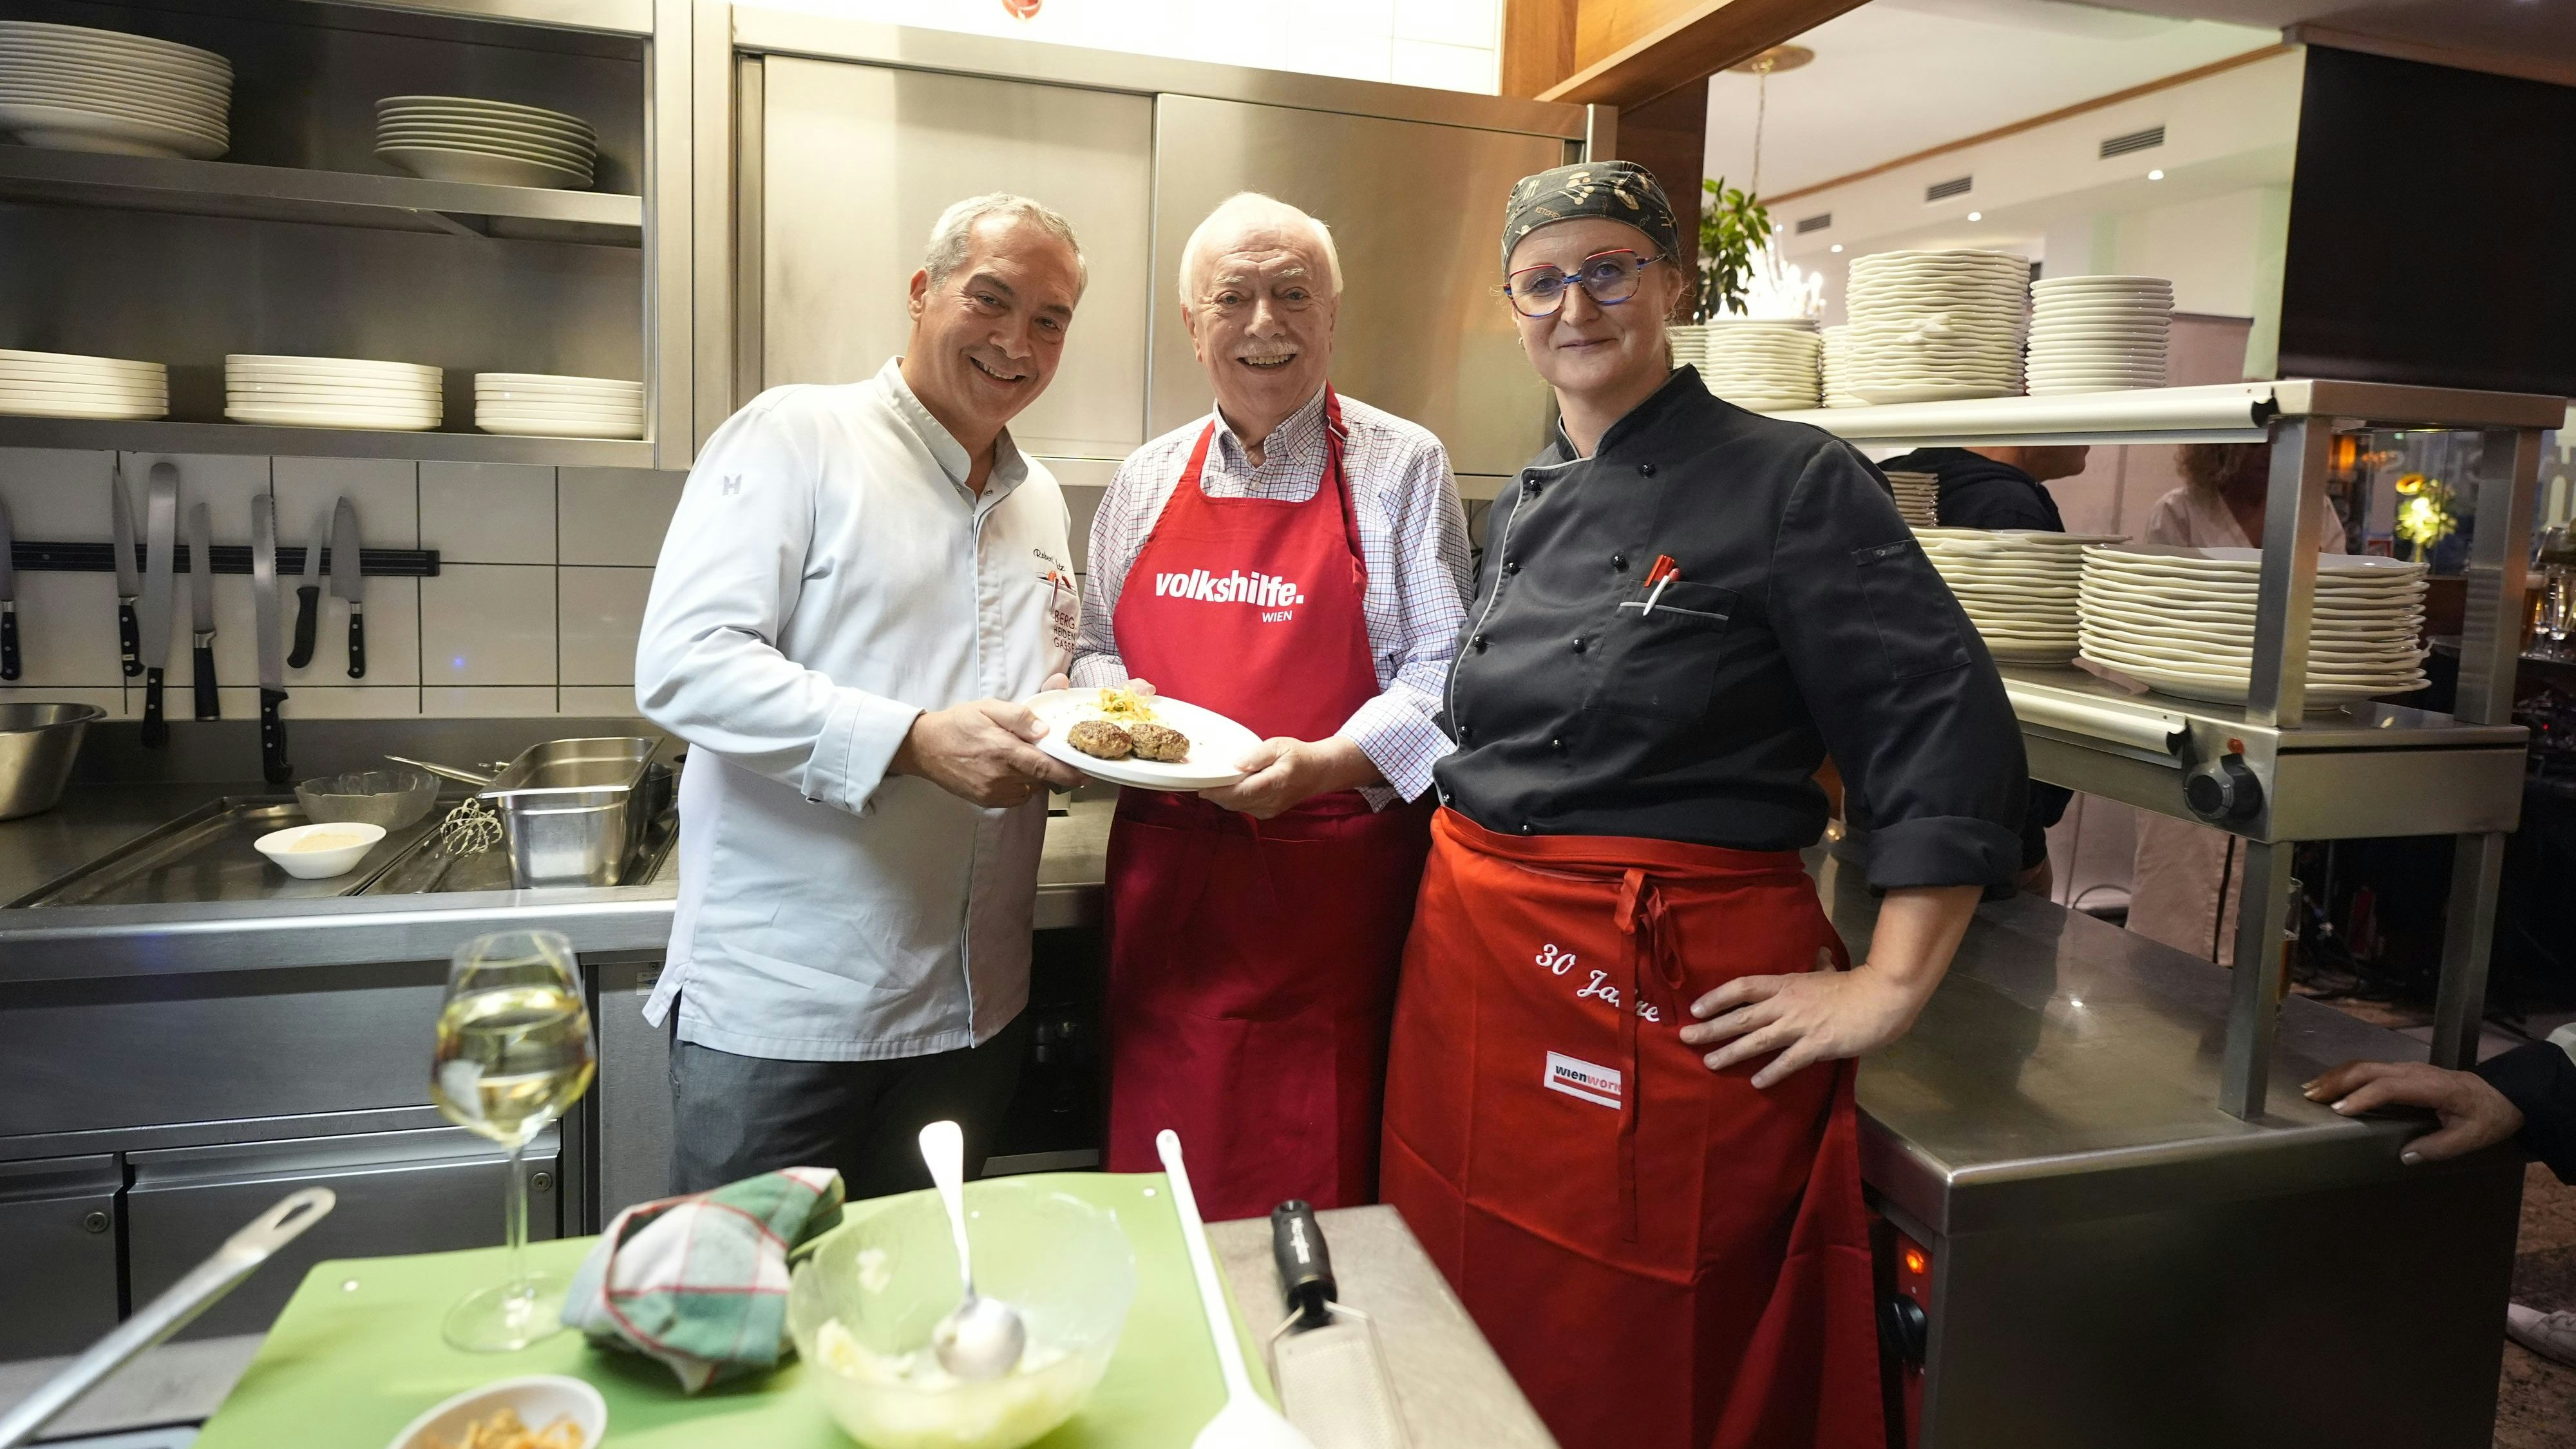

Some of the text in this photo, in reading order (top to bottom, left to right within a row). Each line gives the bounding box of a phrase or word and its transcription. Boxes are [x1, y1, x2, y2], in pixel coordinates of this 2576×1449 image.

[1155, 569, 1304, 607] volkshilfe.
[1054, 610, 1075, 629] BERG
[1262, 610, 1293, 623] WIEN
[1054, 625, 1075, 642] HEIDEN
[1054, 637, 1075, 654] GASSE
[1535, 943, 1660, 1022] 30 Jare
